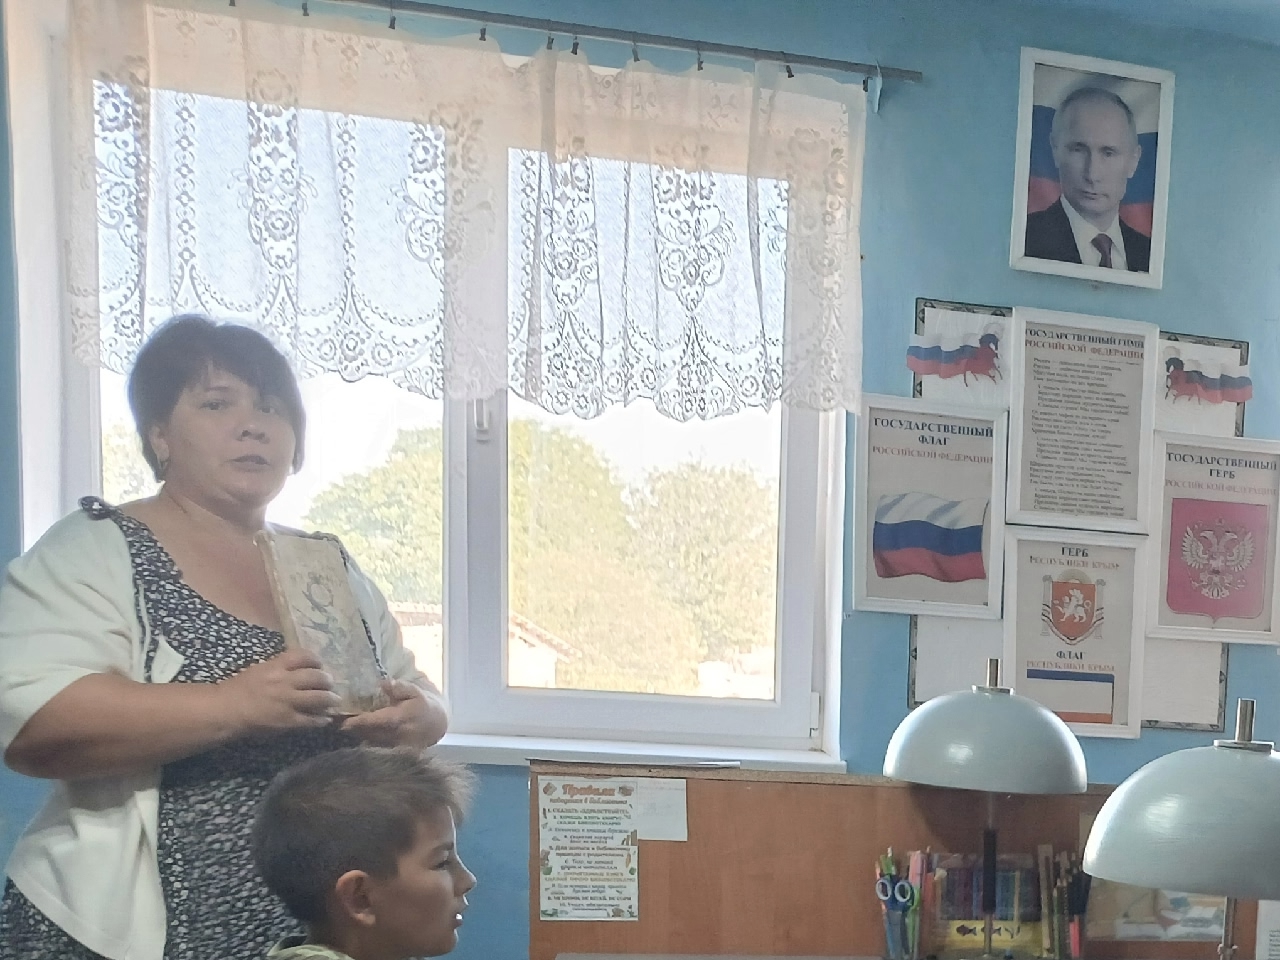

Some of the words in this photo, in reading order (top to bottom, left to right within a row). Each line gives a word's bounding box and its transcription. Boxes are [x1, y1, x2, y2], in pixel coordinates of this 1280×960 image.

[873, 416, 994, 438] ГОСУДАРСТВЕННЫЙ
[918, 434, 951, 446] ФЛАГ
[872, 445, 937, 459] РОССИЙСКОЙ
[1167, 451, 1278, 471] ГОСУДАРСТВЕННЫЙ
[1209, 468, 1236, 480] ГЕРБ
[1061, 546, 1089, 558] ГЕРБ
[1056, 650, 1086, 660] ФЛАГ
